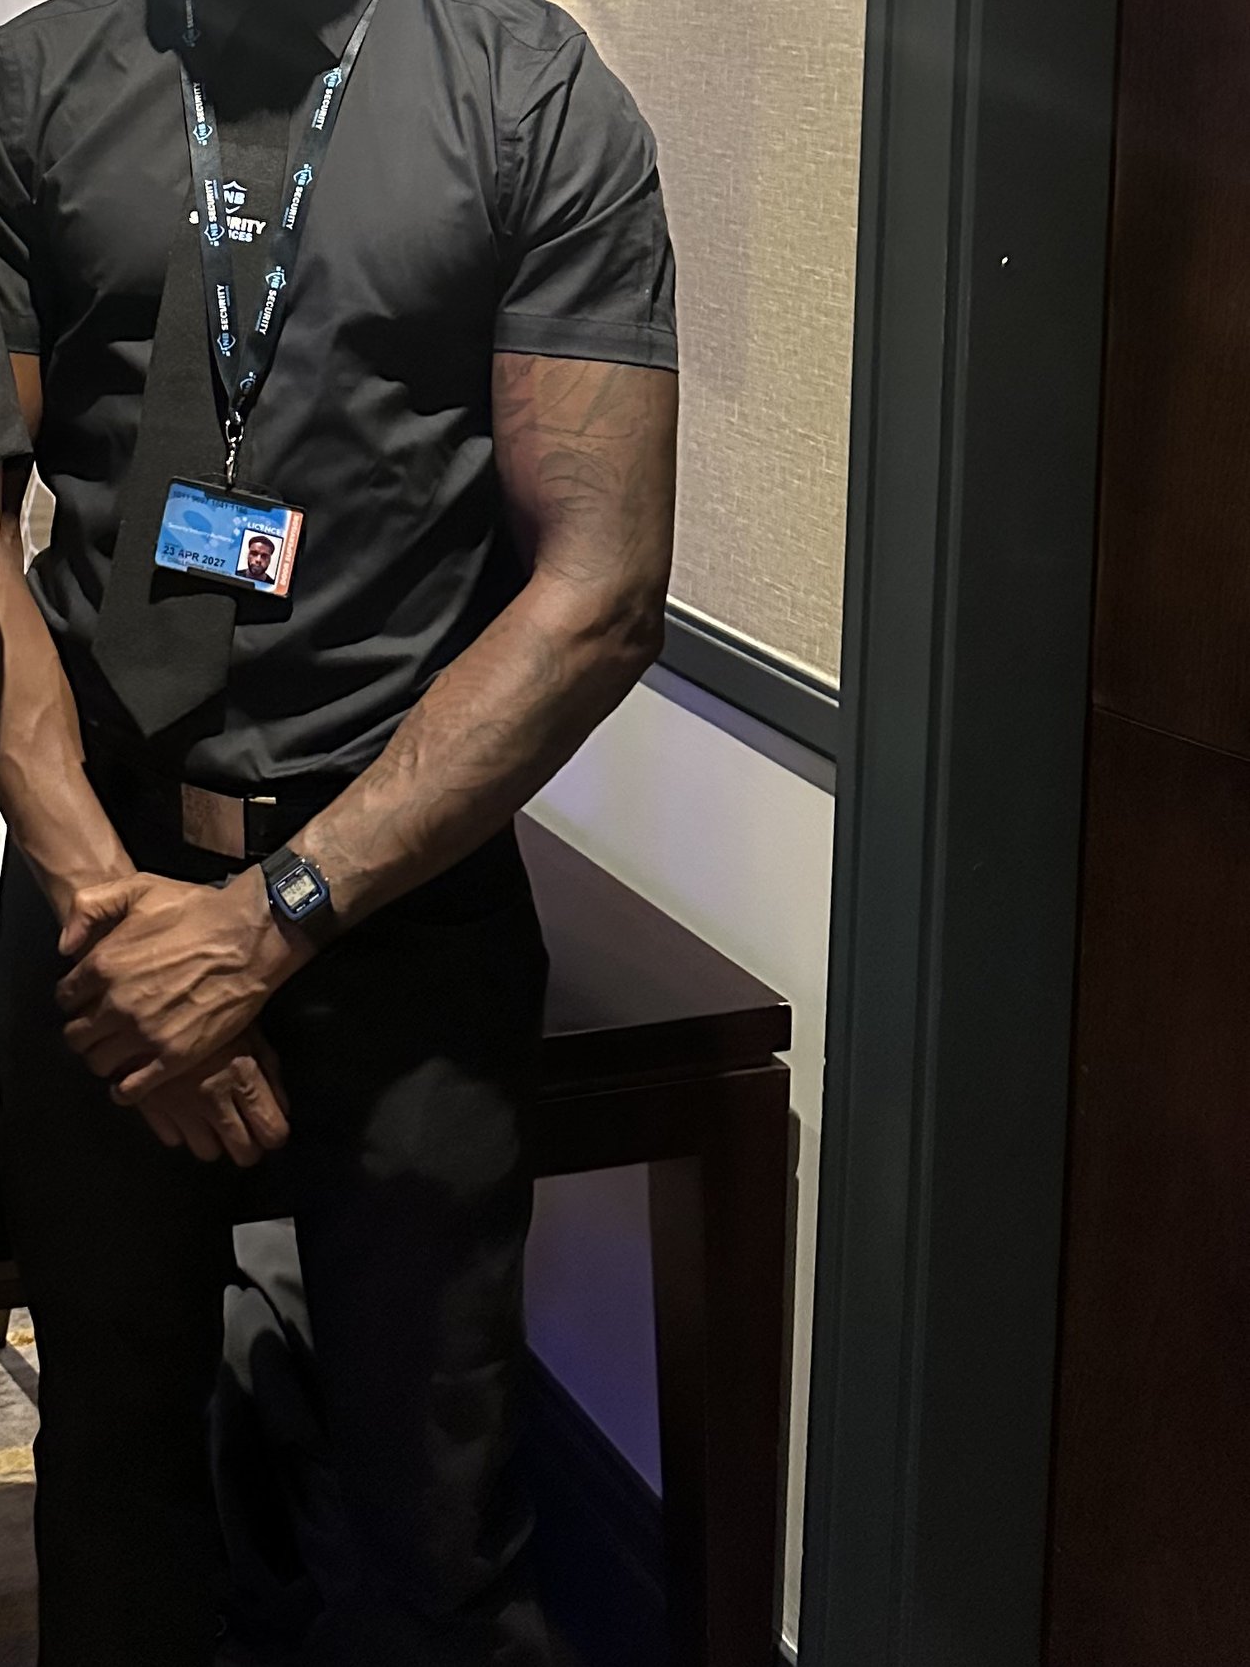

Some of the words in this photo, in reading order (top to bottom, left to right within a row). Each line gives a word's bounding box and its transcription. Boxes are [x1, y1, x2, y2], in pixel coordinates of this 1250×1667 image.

[193, 82, 206, 122] SECURITY
[315, 88, 333, 130] SECURITY
[204, 179, 217, 222] SECURITY
[223, 190, 246, 205] NB
[285, 186, 303, 230] SECURITY
[216, 284, 229, 331] SECURITY
[259, 289, 277, 335] SECURITY
[247, 521, 282, 535] LICENCE
[163, 545, 175, 556] 23
[177, 549, 200, 562] APR
[201, 554, 227, 568] 2027
